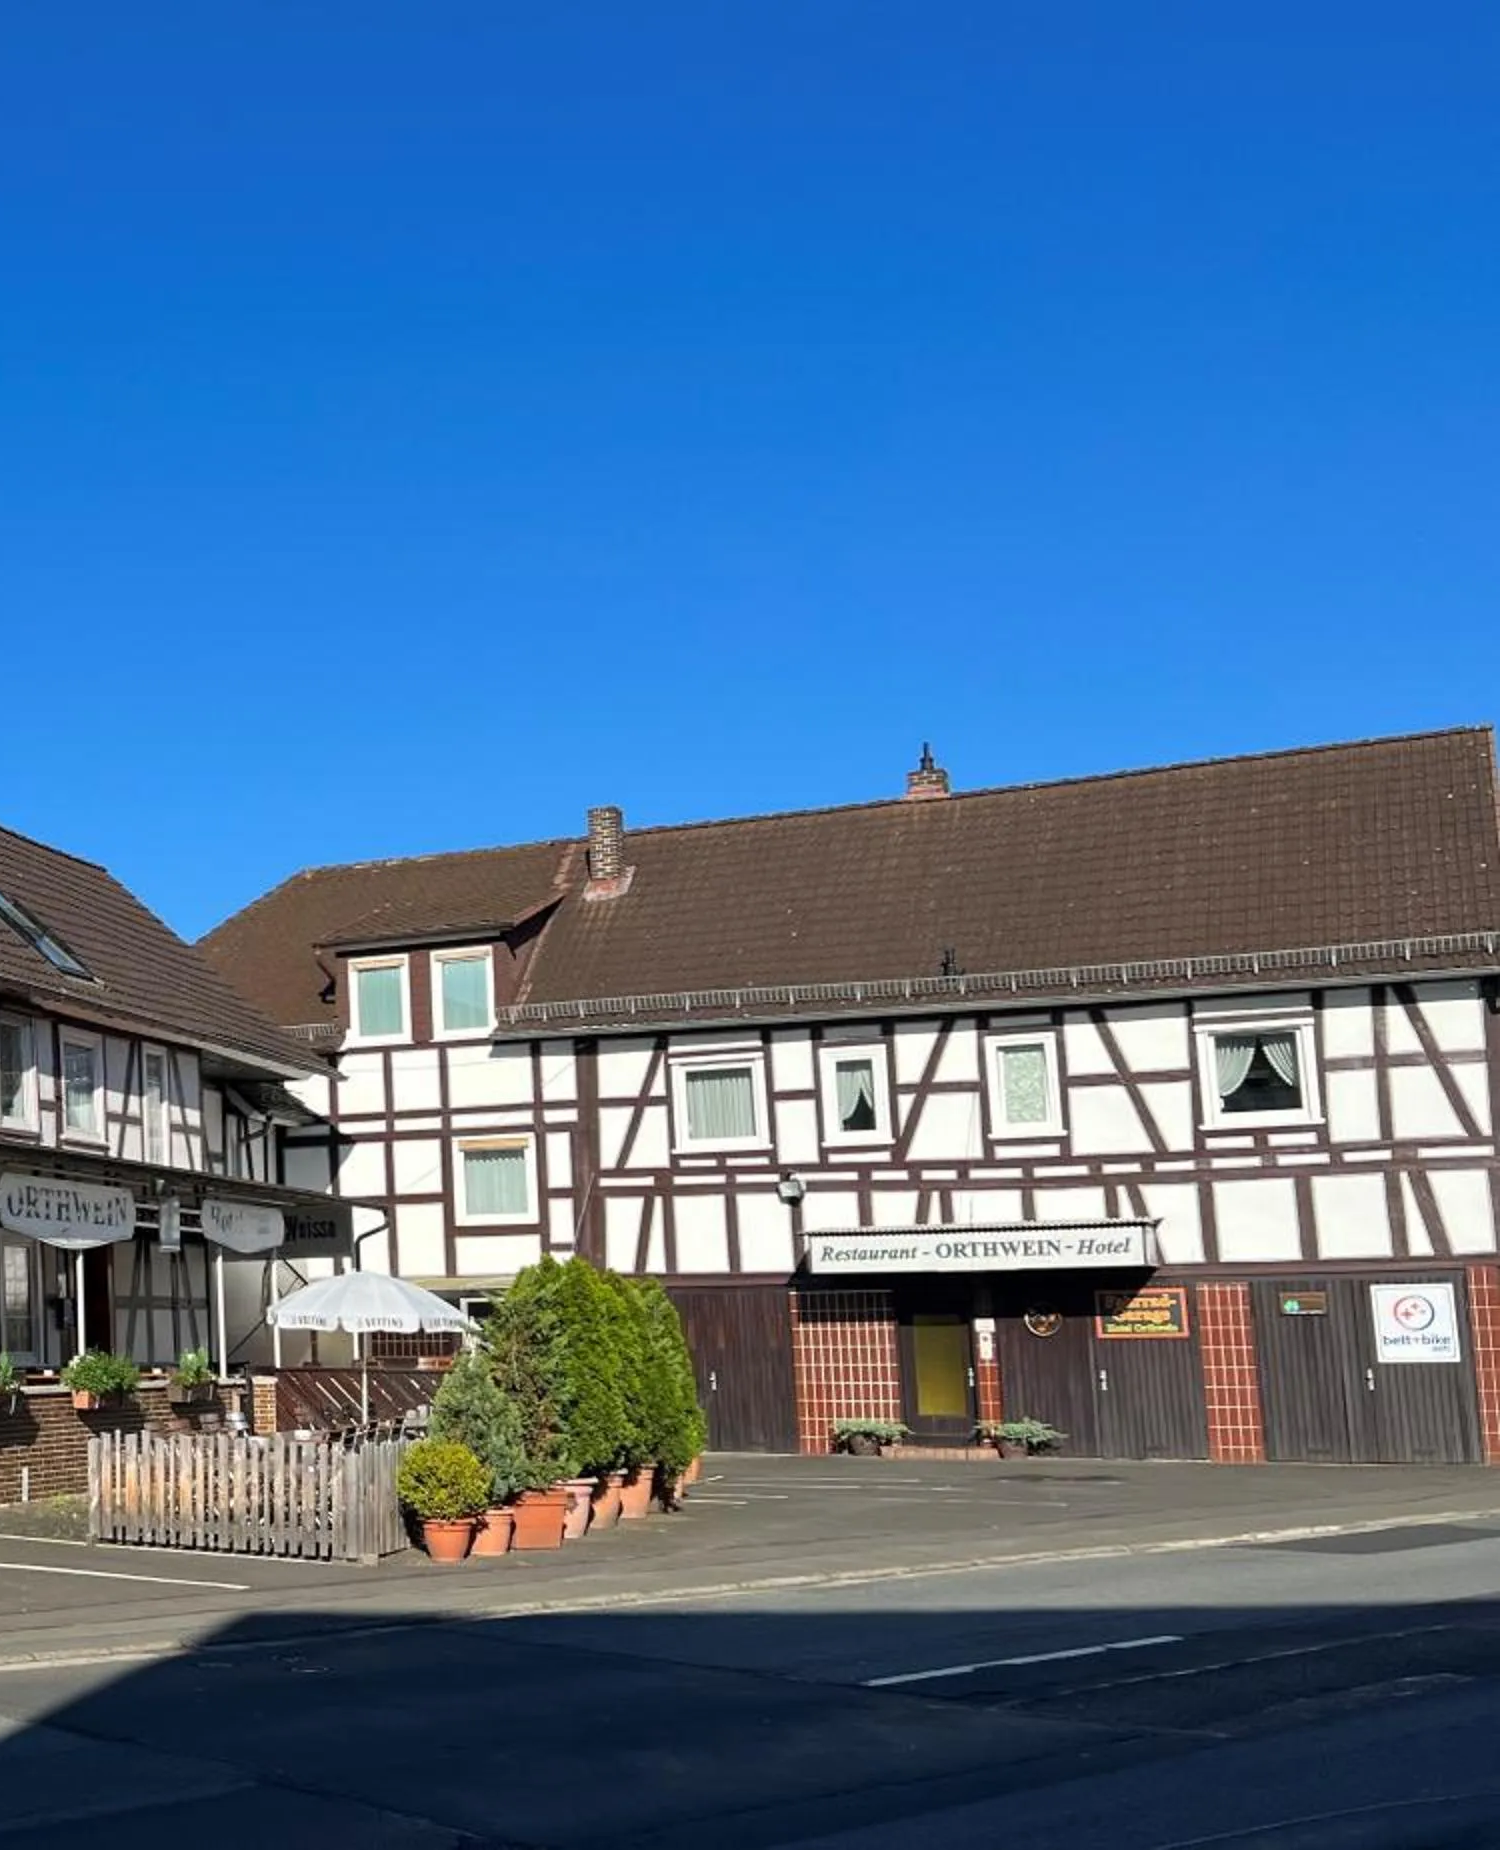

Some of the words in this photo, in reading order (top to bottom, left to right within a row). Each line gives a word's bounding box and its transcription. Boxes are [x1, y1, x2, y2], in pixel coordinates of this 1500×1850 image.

[7, 1184, 128, 1227] ORTHWEIN
[821, 1245, 917, 1262] Restaurant
[935, 1239, 1061, 1259] ORTHWEIN
[1077, 1237, 1130, 1256] Hotel
